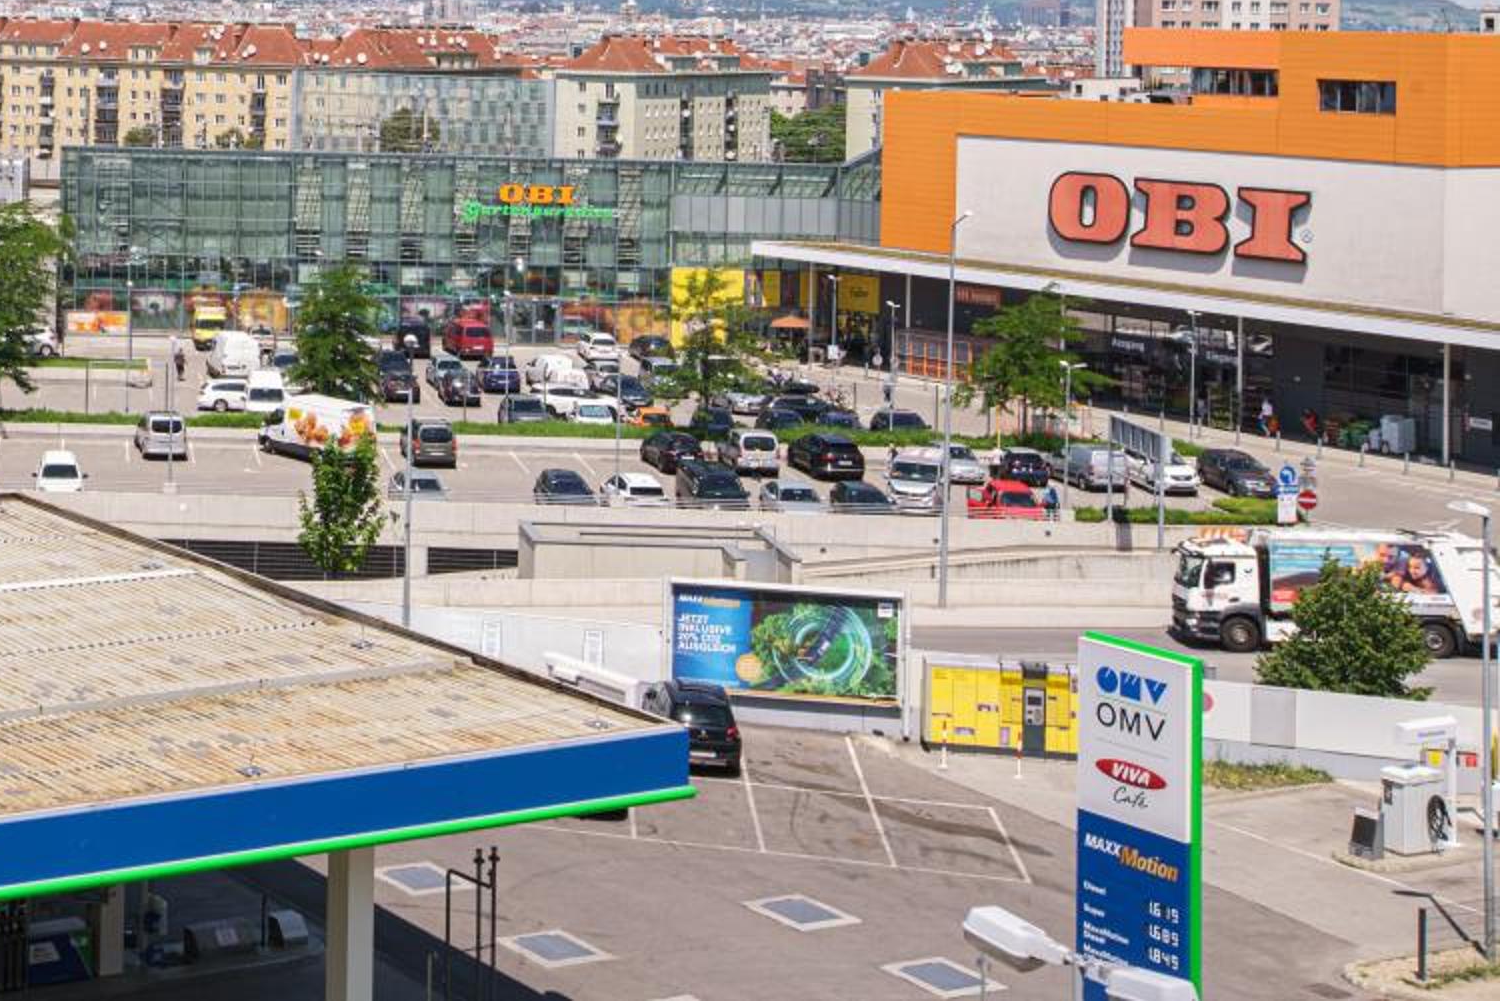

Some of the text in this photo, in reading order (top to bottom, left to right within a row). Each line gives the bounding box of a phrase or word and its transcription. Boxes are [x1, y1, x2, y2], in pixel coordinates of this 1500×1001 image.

[498, 183, 576, 205] OBI
[1049, 170, 1312, 263] OBI
[1097, 702, 1165, 740] OMV
[1111, 762, 1151, 786] VIVA
